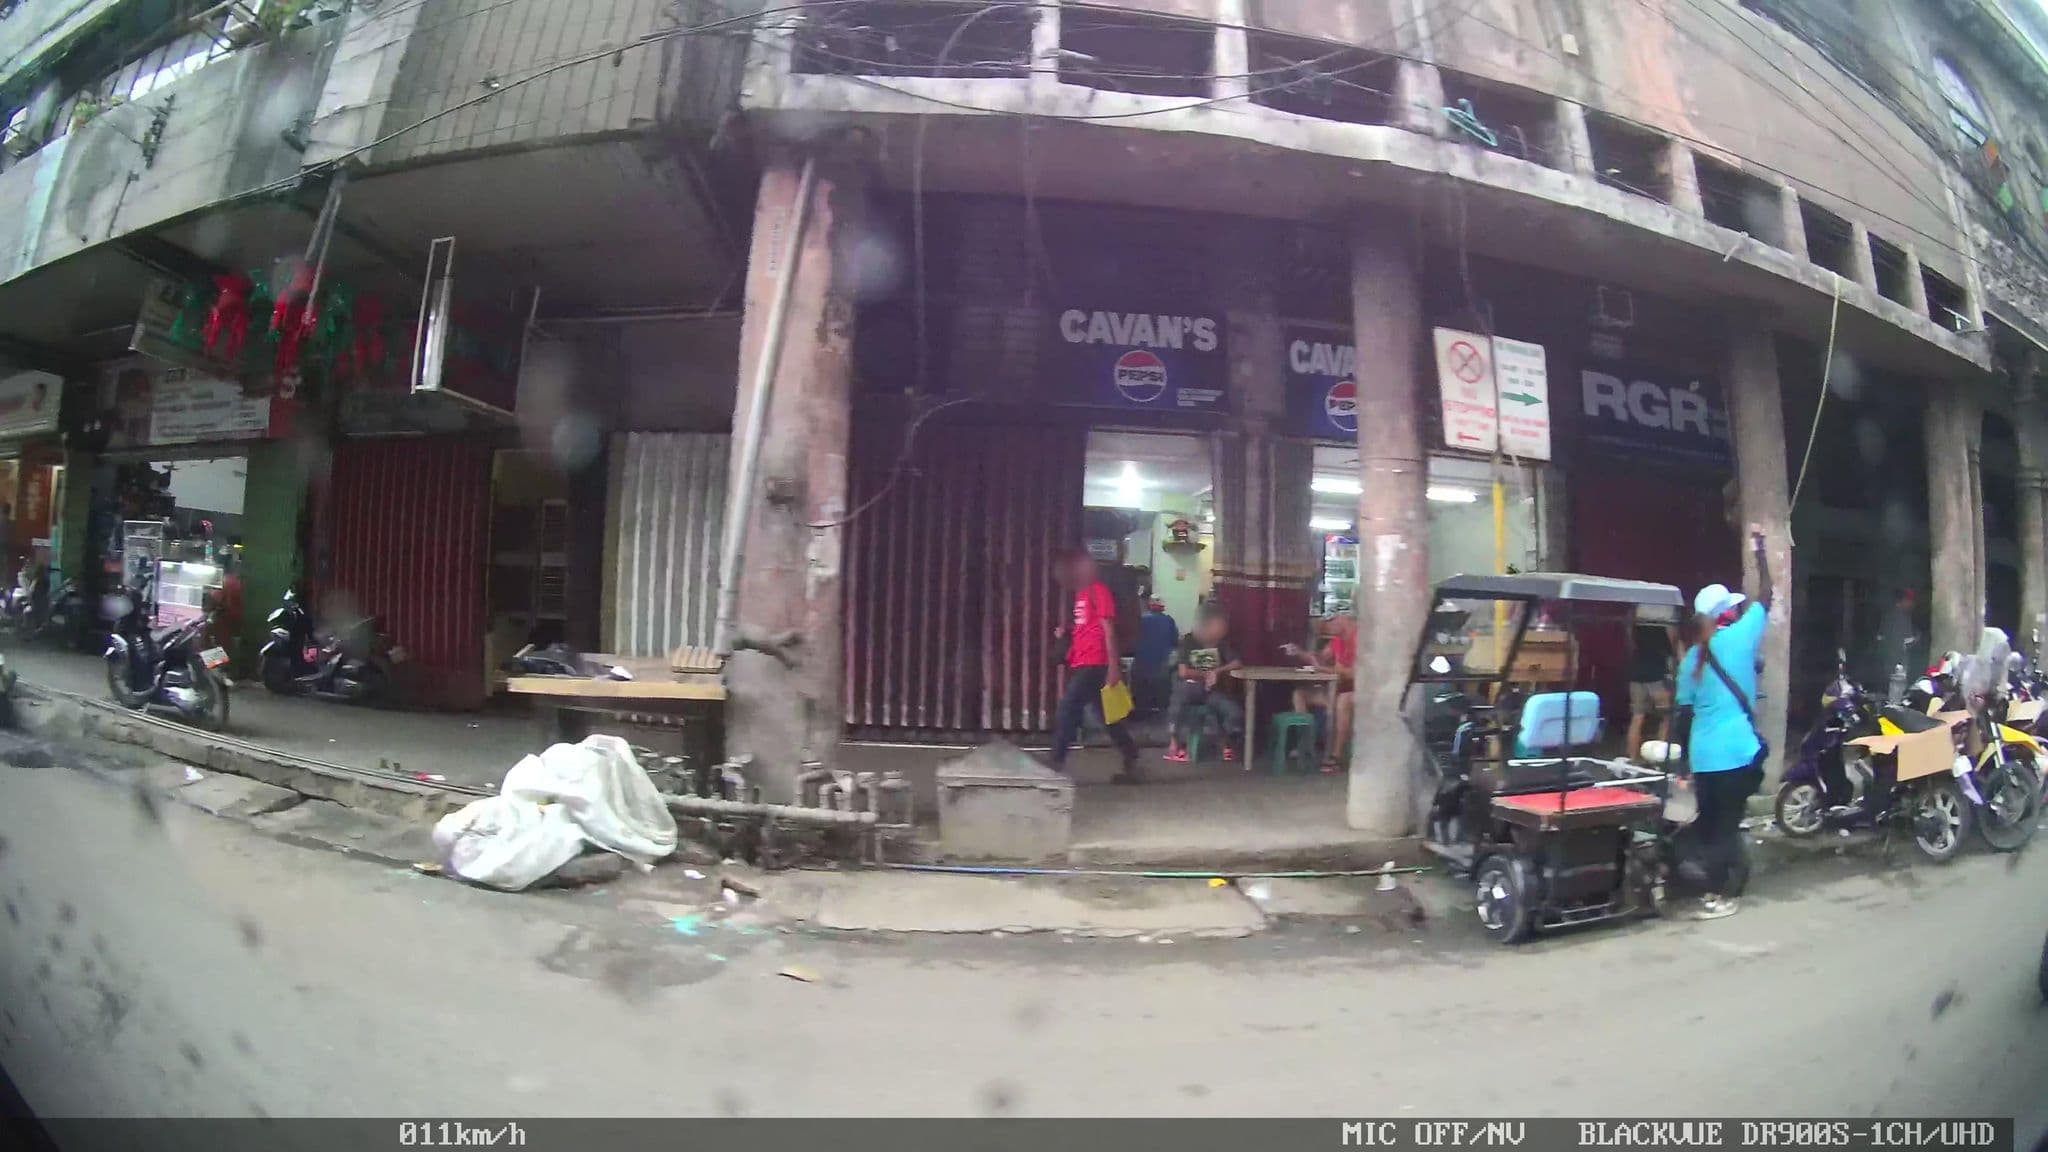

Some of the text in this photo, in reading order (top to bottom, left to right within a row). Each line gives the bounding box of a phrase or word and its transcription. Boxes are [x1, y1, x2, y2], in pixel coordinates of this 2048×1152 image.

[1059, 309, 1218, 351] CAVAN'S
[1118, 368, 1164, 382] PEPSI
[1289, 340, 1357, 377] CAVA
